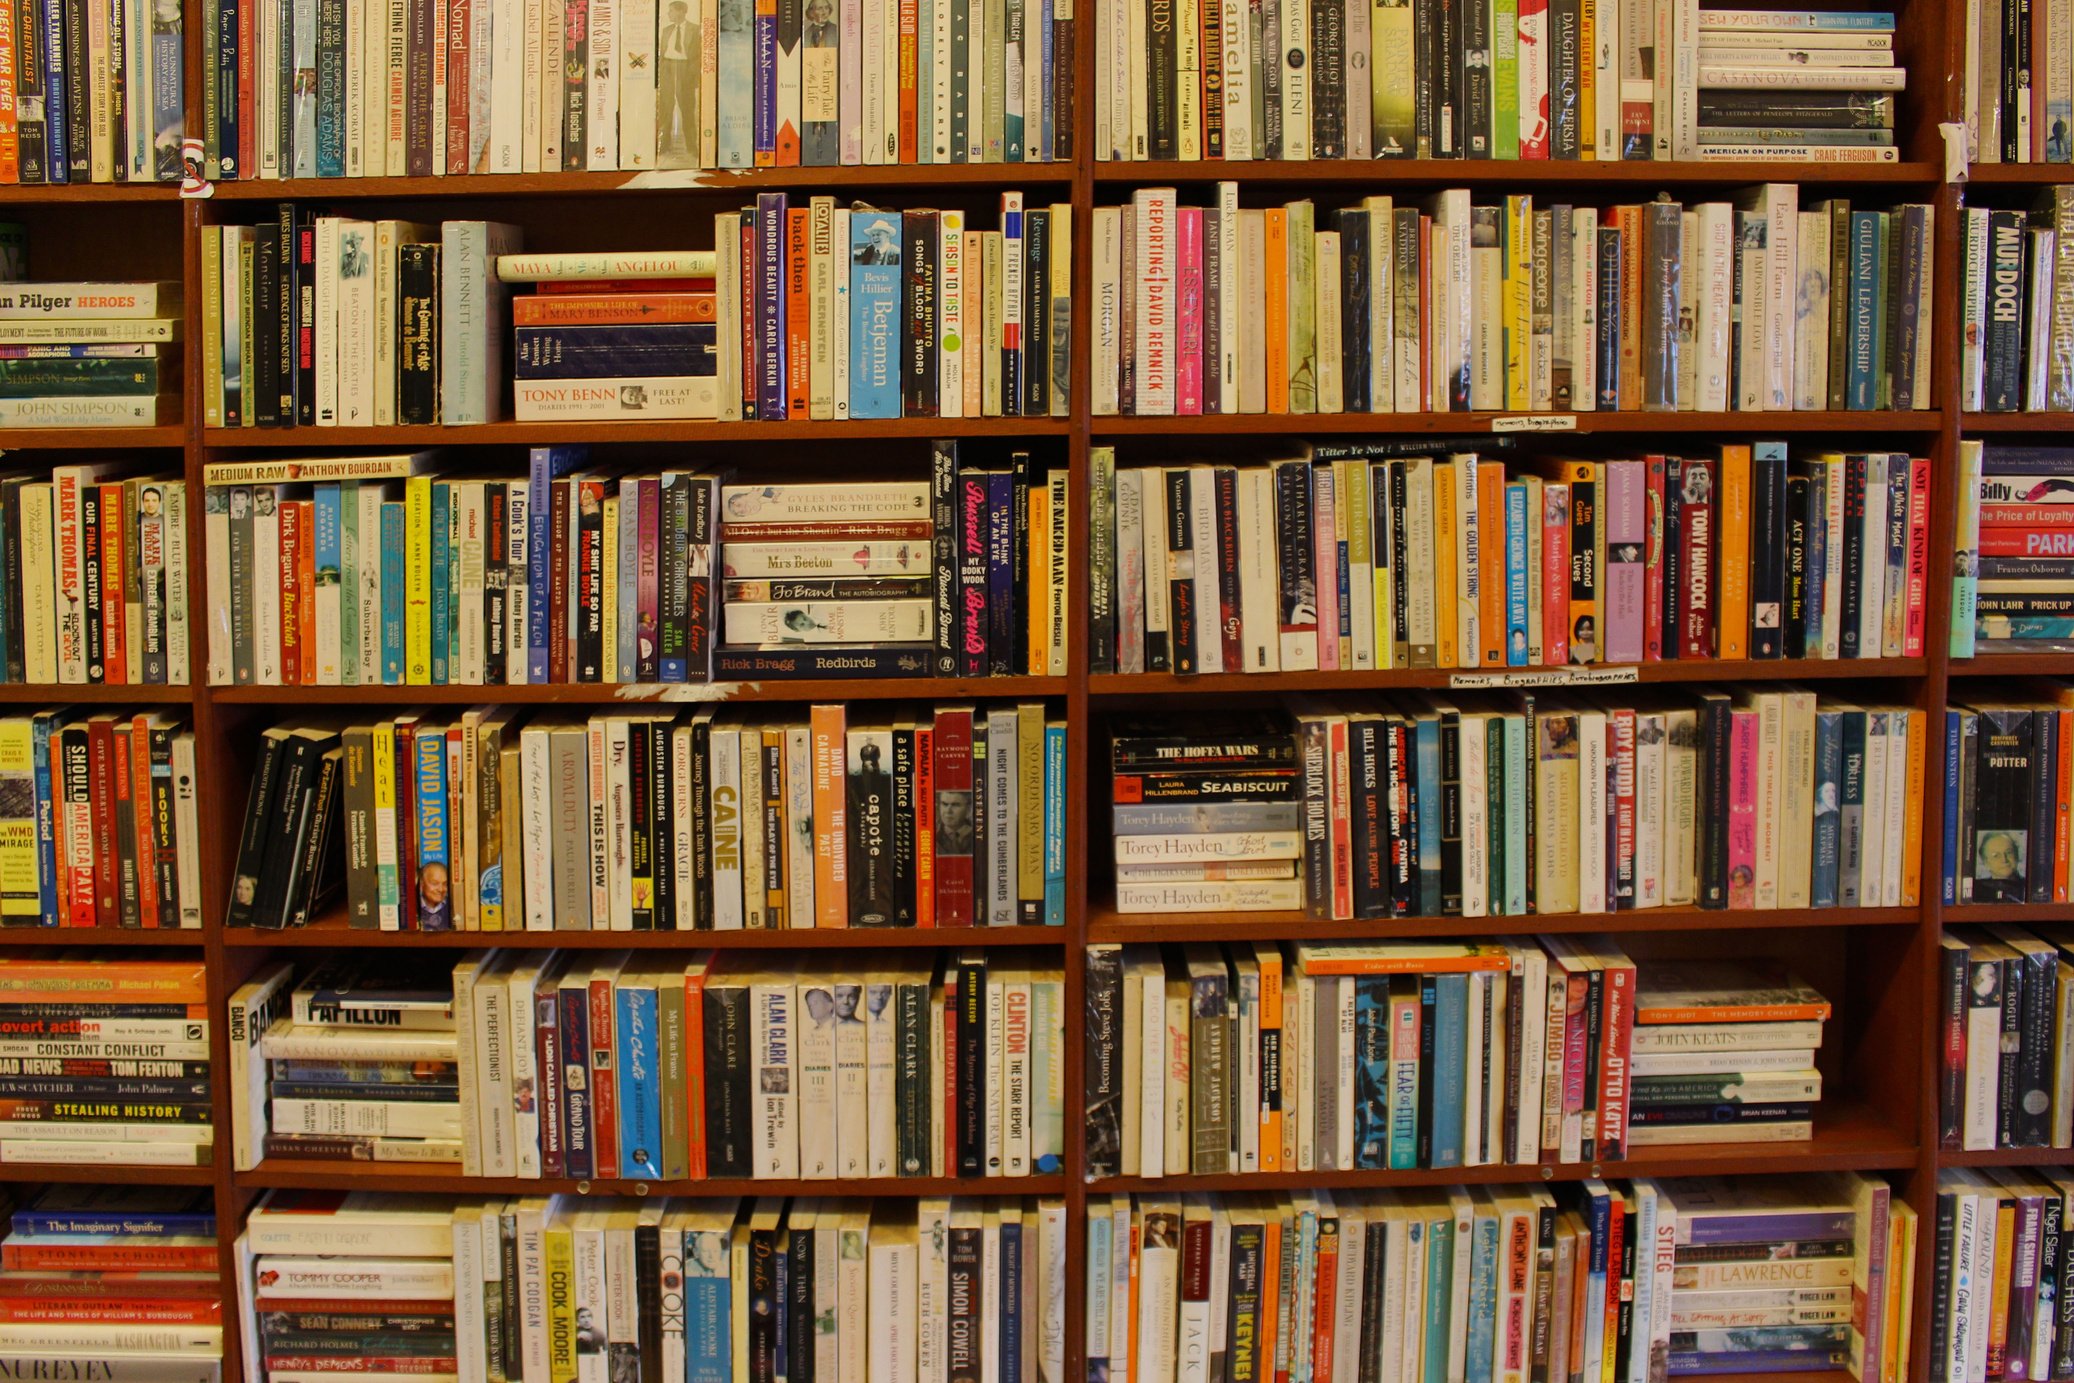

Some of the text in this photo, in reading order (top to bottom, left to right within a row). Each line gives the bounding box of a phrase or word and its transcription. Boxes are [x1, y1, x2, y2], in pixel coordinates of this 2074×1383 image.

[1, 9, 12, 111] BEST WAR EVER
[19, 17, 33, 83] ORIENTALIST
[1583, 21, 1591, 88] MY SILENT WAR
[322, 52, 333, 160] DOUGLAS ADAMS
[1291, 75, 1302, 115] ELENI
[1814, 149, 1877, 161] CRAIG FERGUSON
[615, 261, 681, 273] ANGELOU
[767, 210, 777, 301] WONDROUS BEAUTY
[793, 215, 805, 293] back then
[1149, 200, 1163, 275] REPORTING
[1860, 219, 1872, 281] GIULIANI
[513, 263, 551, 274] MAYA
[860, 283, 893, 294] Hillier
[864, 273, 889, 283] Bevis
[946, 234, 958, 323] SEASON TO TASTE
[1995, 226, 2018, 321] MURDOCH
[20, 294, 135, 308] Pilger HEROES
[915, 240, 924, 375] SONGS BLOOD SWORD
[1858, 287, 1871, 373] LEADERSHIP
[766, 318, 776, 386] CAROL BERKIN
[873, 300, 893, 388] Betjeman
[1148, 286, 1163, 390] DAVID REMNICK
[17, 401, 127, 415] JOHN SIMPSON
[522, 388, 616, 402] TONY BENN
[210, 462, 392, 481] MEDIUM RAW ANTHONY BOURDAIN
[1980, 479, 2012, 501] Billy
[60, 476, 77, 590] MARK THOMAS
[86, 502, 99, 610] OUR FINAL CENTURY
[768, 555, 833, 569] Mrs Beeton
[968, 558, 979, 566] MY
[1690, 509, 1708, 611] TONY HANCOCK
[1912, 466, 1926, 609] NOT THAT KIND OF GIRL
[283, 509, 295, 647] Dirk Bogarde Backcloth
[580, 530, 590, 607] FRANKIE BOYLE
[590, 530, 600, 633] MY SHIT LIFE SO FAR
[962, 566, 986, 575] BOOKY
[963, 575, 985, 584] WOOK
[1997, 563, 2064, 574] Frances Osborne
[147, 570, 158, 653] EXTREME RAMBLING
[722, 658, 795, 671] Rick Bragg
[816, 656, 876, 669] Redbirds
[1157, 745, 1259, 758] THE HOFFA WARS
[1364, 728, 1375, 788] BILL HICKS
[1617, 716, 1633, 797] ROY HUDD
[1990, 758, 2027, 768] POTTER
[159, 787, 168, 847] BOOKS
[420, 741, 442, 853] DAVID JASON
[1202, 781, 1289, 793] SEABISCUIT
[1306, 747, 1325, 840] SHERLOCK HOLMES
[72, 745, 92, 905] SHOULD AMERICA PAY?
[594, 804, 605, 887] THIS IS HOW
[713, 787, 738, 871] CAINE
[869, 794, 881, 857] capote
[1120, 813, 1194, 827] Torey Hayden
[1121, 839, 1222, 855] Torey Hayden
[1120, 889, 1220, 905] Torey Hayden
[37, 1044, 165, 1056] CONSTANT CONFLICT
[50, 1021, 100, 1032] action
[232, 1007, 244, 1041] BANCO
[769, 994, 787, 1065] ALAN CLARK
[1099, 990, 1113, 1093] Becoming Steve Jobs
[1548, 1005, 1564, 1061] JUMBO
[23, 1058, 62, 1075] NEWS
[111, 1062, 183, 1077] TOM FENTON
[117, 1083, 175, 1094] John Palmer
[1008, 992, 1027, 1140] CLINTON THE STARR REPORT
[54, 1104, 181, 1117] STEALING HISTORY
[1605, 1057, 1623, 1140] OTTO KATZ
[47, 1222, 163, 1233] The Imaginary Signifier
[1657, 1226, 1674, 1273] STIEG
[2021, 1208, 2037, 1287] FRANK SKINNER
[2045, 1207, 2060, 1267] Nigel Slater
[288, 1274, 381, 1282] TOMMY COOPER
[525, 1232, 540, 1328] TIM PAT COOGAN
[551, 1271, 568, 1309] COOK
[1721, 1264, 1814, 1281] LAWRENCE
[273, 1341, 359, 1350] RICHARD HOLMES
[555, 1314, 570, 1366] MOORE
[952, 1273, 968, 1370] SIMON COWELL
